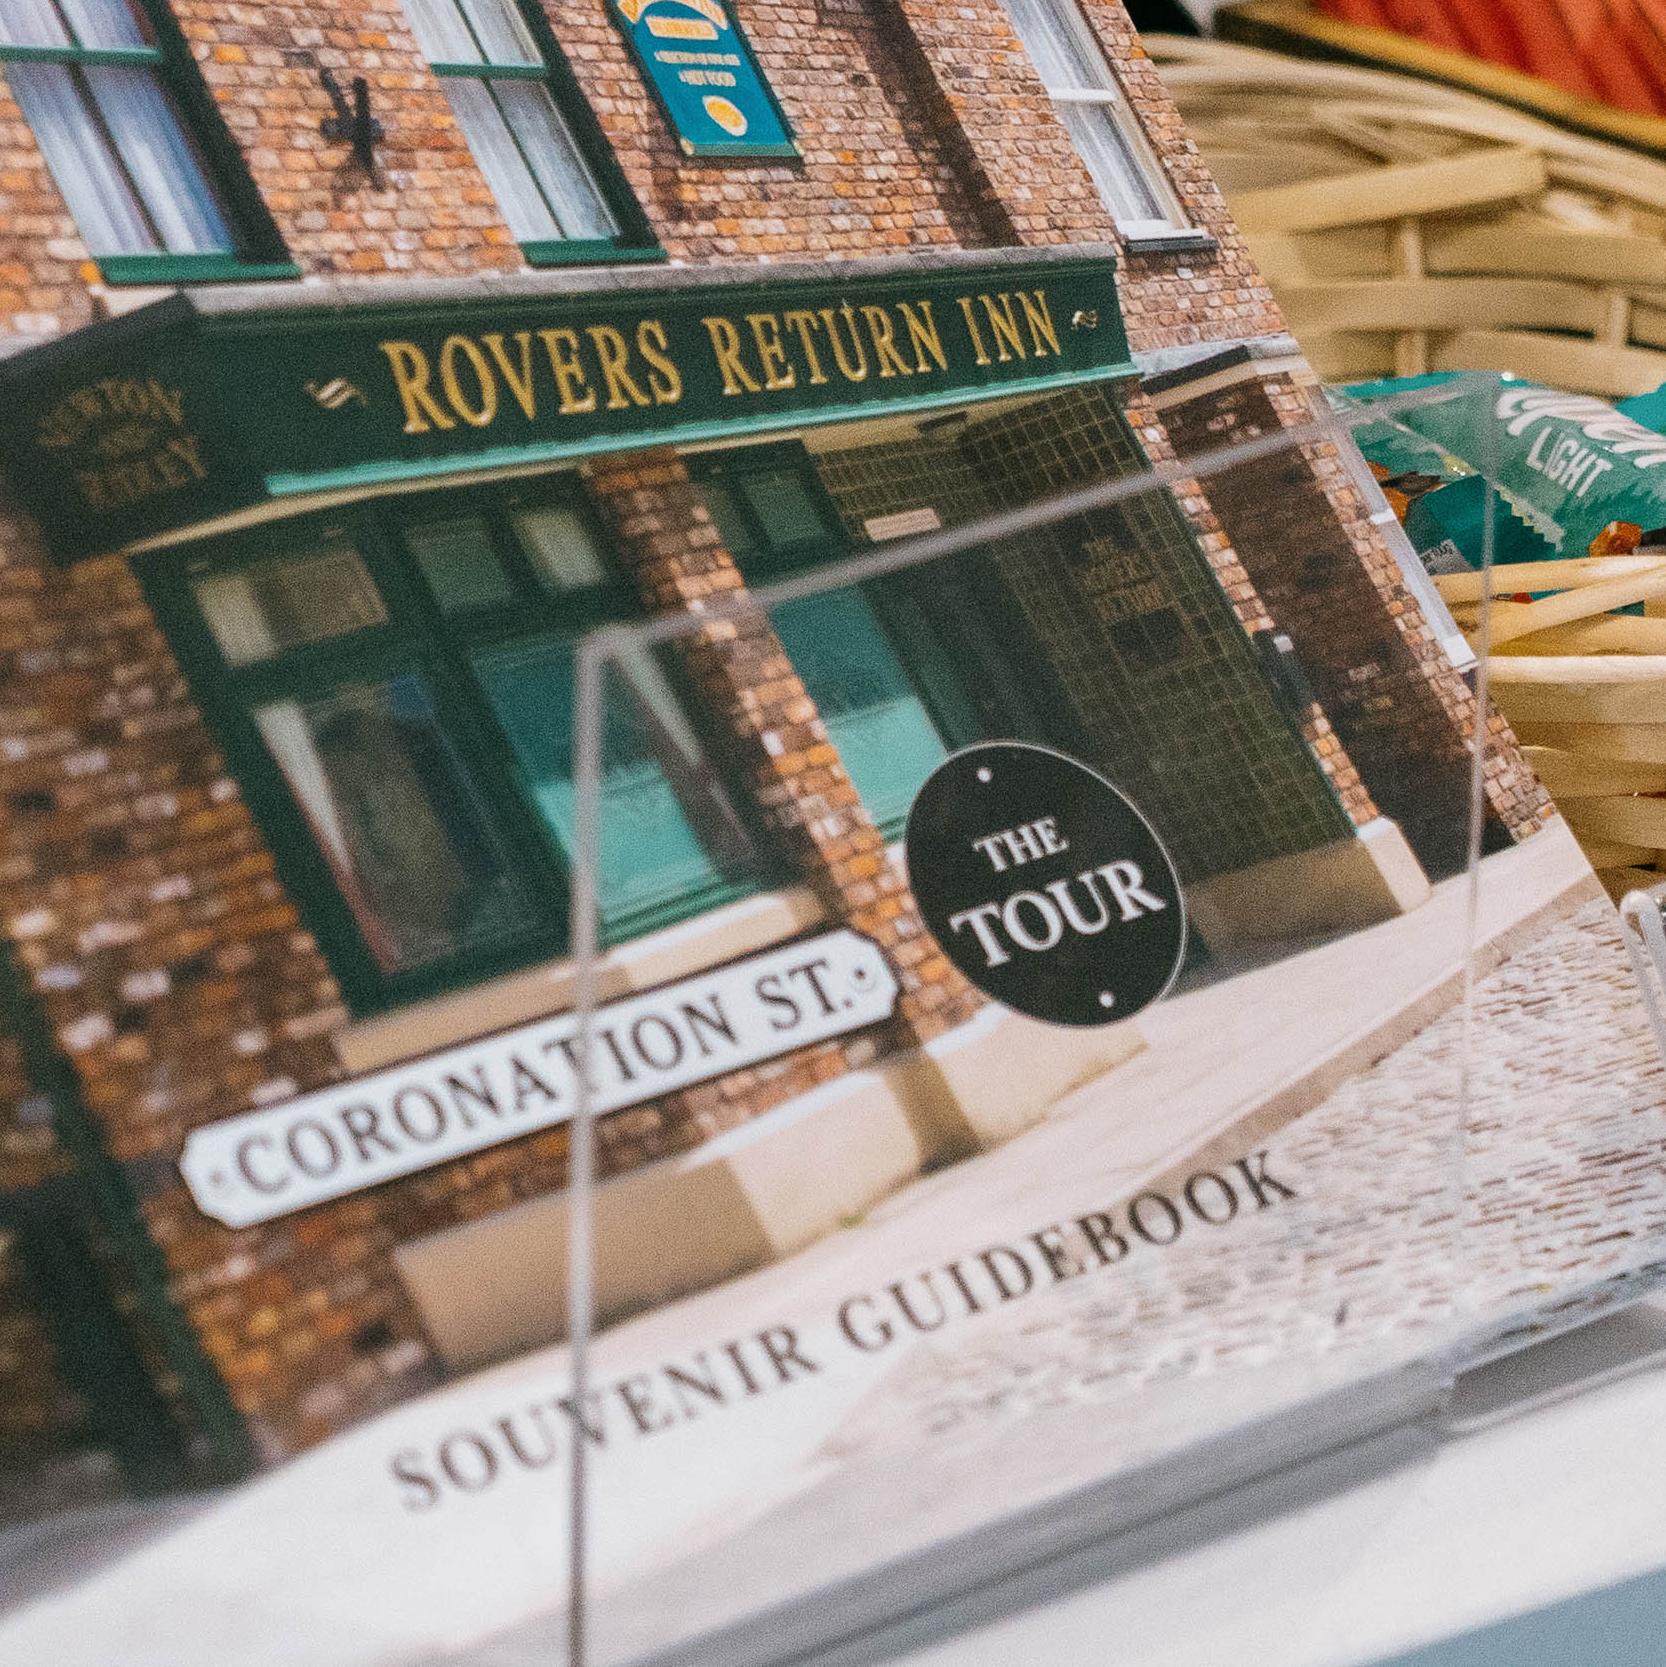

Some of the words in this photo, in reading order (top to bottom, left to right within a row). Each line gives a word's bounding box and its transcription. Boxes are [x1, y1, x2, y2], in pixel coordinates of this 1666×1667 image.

[380, 317, 685, 436] ROVERS
[703, 301, 949, 397] RETURN
[956, 289, 1065, 367] INN
[1526, 427, 1613, 498] LIGHT
[974, 817, 1068, 871] THE
[950, 859, 1165, 965] TOUR
[231, 993, 735, 1198] CORONATION
[756, 957, 855, 1033] ST.
[391, 1321, 822, 1514] SOUVENIR
[838, 1151, 1298, 1354] GUIDEBOOK
